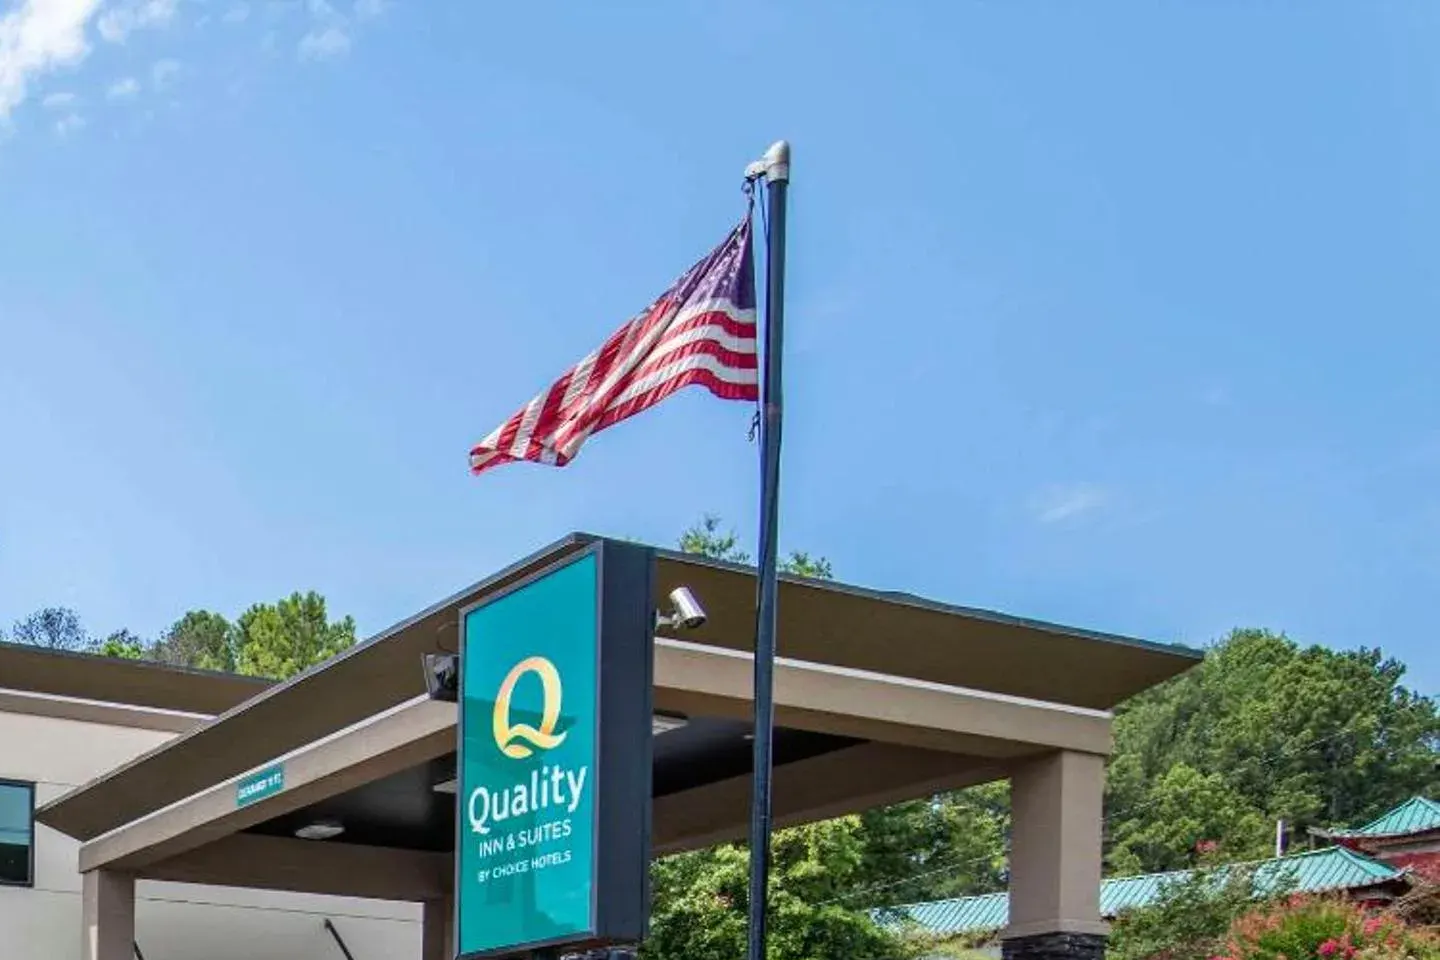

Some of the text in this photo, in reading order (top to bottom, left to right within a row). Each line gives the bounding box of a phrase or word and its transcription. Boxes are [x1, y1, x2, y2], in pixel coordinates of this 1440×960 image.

[493, 656, 567, 759] Q
[468, 764, 587, 834] Quality
[480, 818, 572, 858] INN & SUITES
[478, 850, 572, 882] BY CHOICE HOTELS
